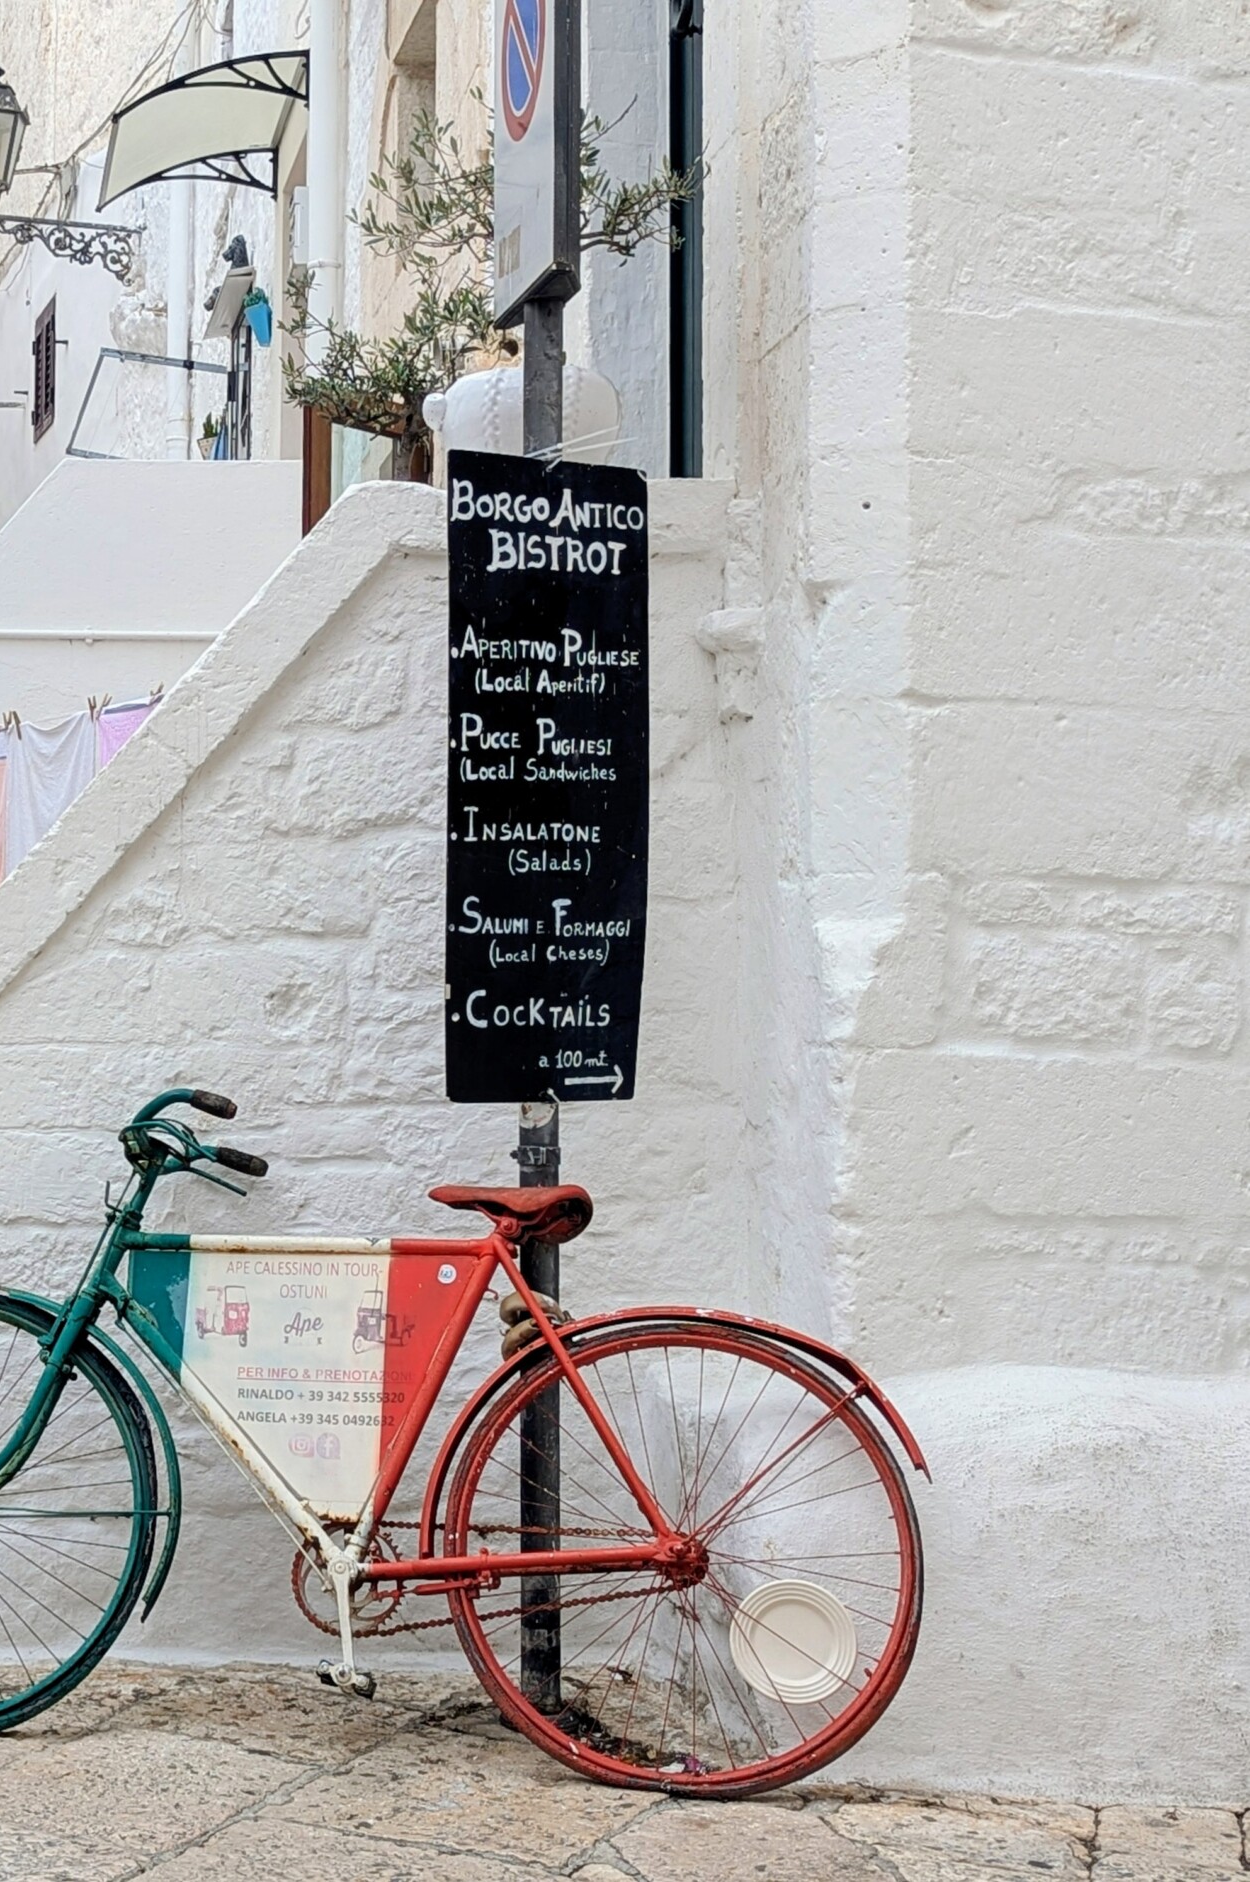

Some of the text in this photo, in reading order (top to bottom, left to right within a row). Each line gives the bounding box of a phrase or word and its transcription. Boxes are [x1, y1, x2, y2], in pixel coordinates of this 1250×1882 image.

[450, 478, 644, 532] BORGO ANTICO
[486, 528, 627, 575] BISTROT
[460, 624, 639, 666] APERITIVO PUGLIESE
[475, 667, 605, 696] (Local Aperitif)
[460, 712, 521, 751] PUCCE
[460, 756, 616, 782] (Local Sandwiches
[463, 806, 600, 843] INSALATONE
[509, 848, 591, 876] (Salads)
[458, 895, 631, 937] SALUMI E FORMAGGI
[489, 939, 535, 968] (Local
[538, 1055, 549, 1068] a
[555, 1049, 583, 1068] 100
[226, 1261, 250, 1274] APE
[254, 1261, 322, 1276] CALESSINO
[326, 1262, 340, 1276] IN
[280, 1284, 328, 1299] OSTUNI
[283, 1312, 324, 1337] Ape
[237, 1366, 264, 1378] PER
[267, 1368, 299, 1379] INFO
[302, 1369, 311, 1380] &
[237, 1388, 294, 1400] RINALDO
[308, 1390, 324, 1402] 39
[327, 1391, 350, 1403] 342
[237, 1411, 287, 1423] ANGELA
[290, 1413, 313, 1425] +39
[316, 1414, 339, 1426] 345
